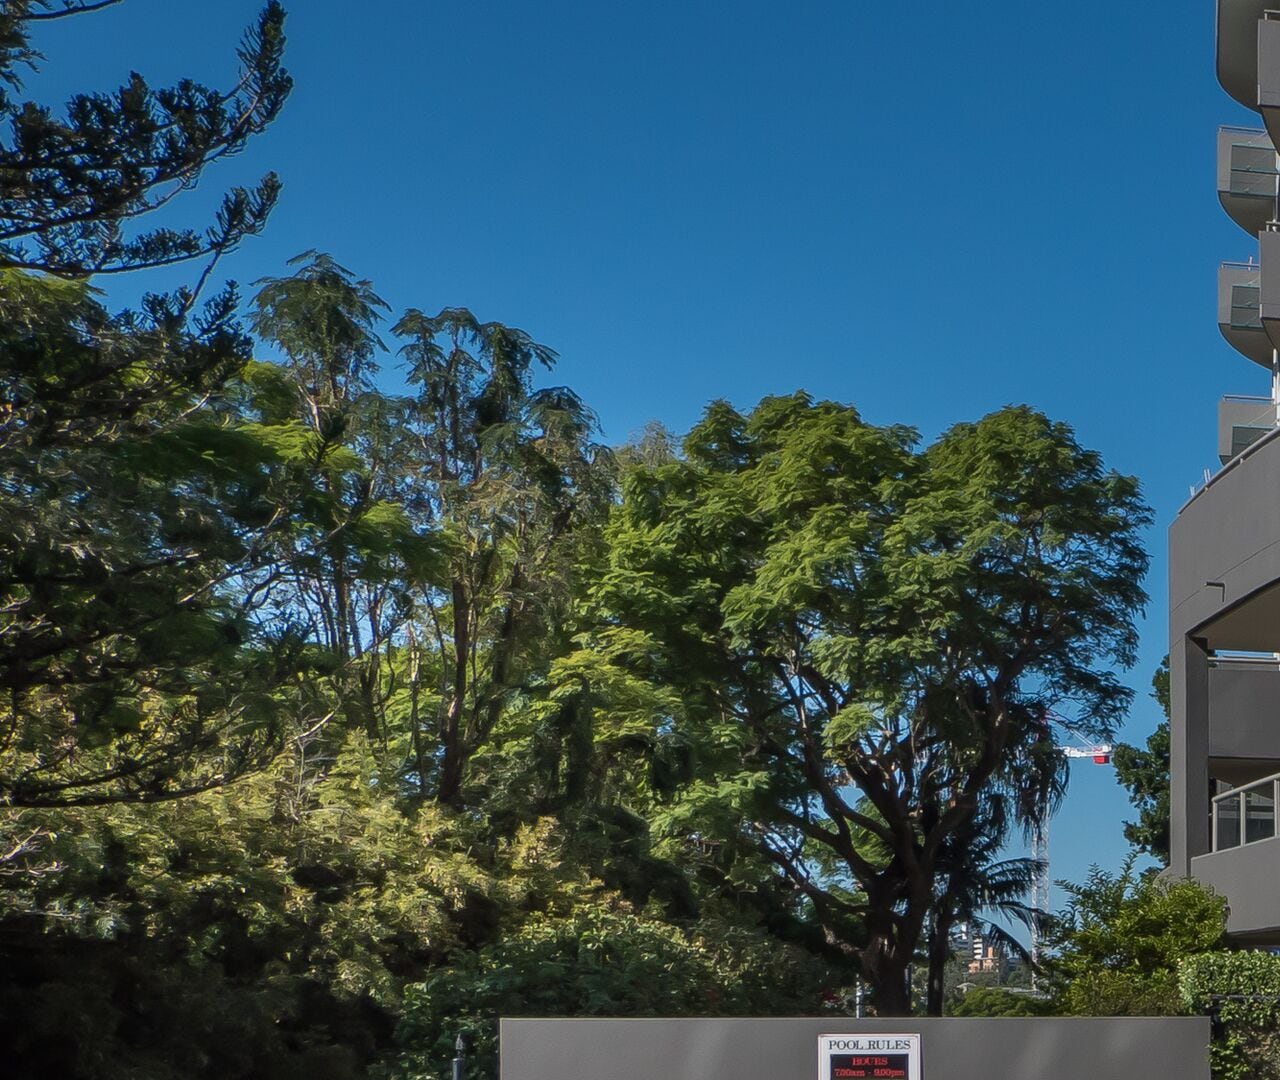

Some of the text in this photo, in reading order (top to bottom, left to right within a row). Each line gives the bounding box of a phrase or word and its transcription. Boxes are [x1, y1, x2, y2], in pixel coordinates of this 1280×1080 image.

[829, 1040, 911, 1050] POOL RULES
[852, 1057, 888, 1065] HOURS
